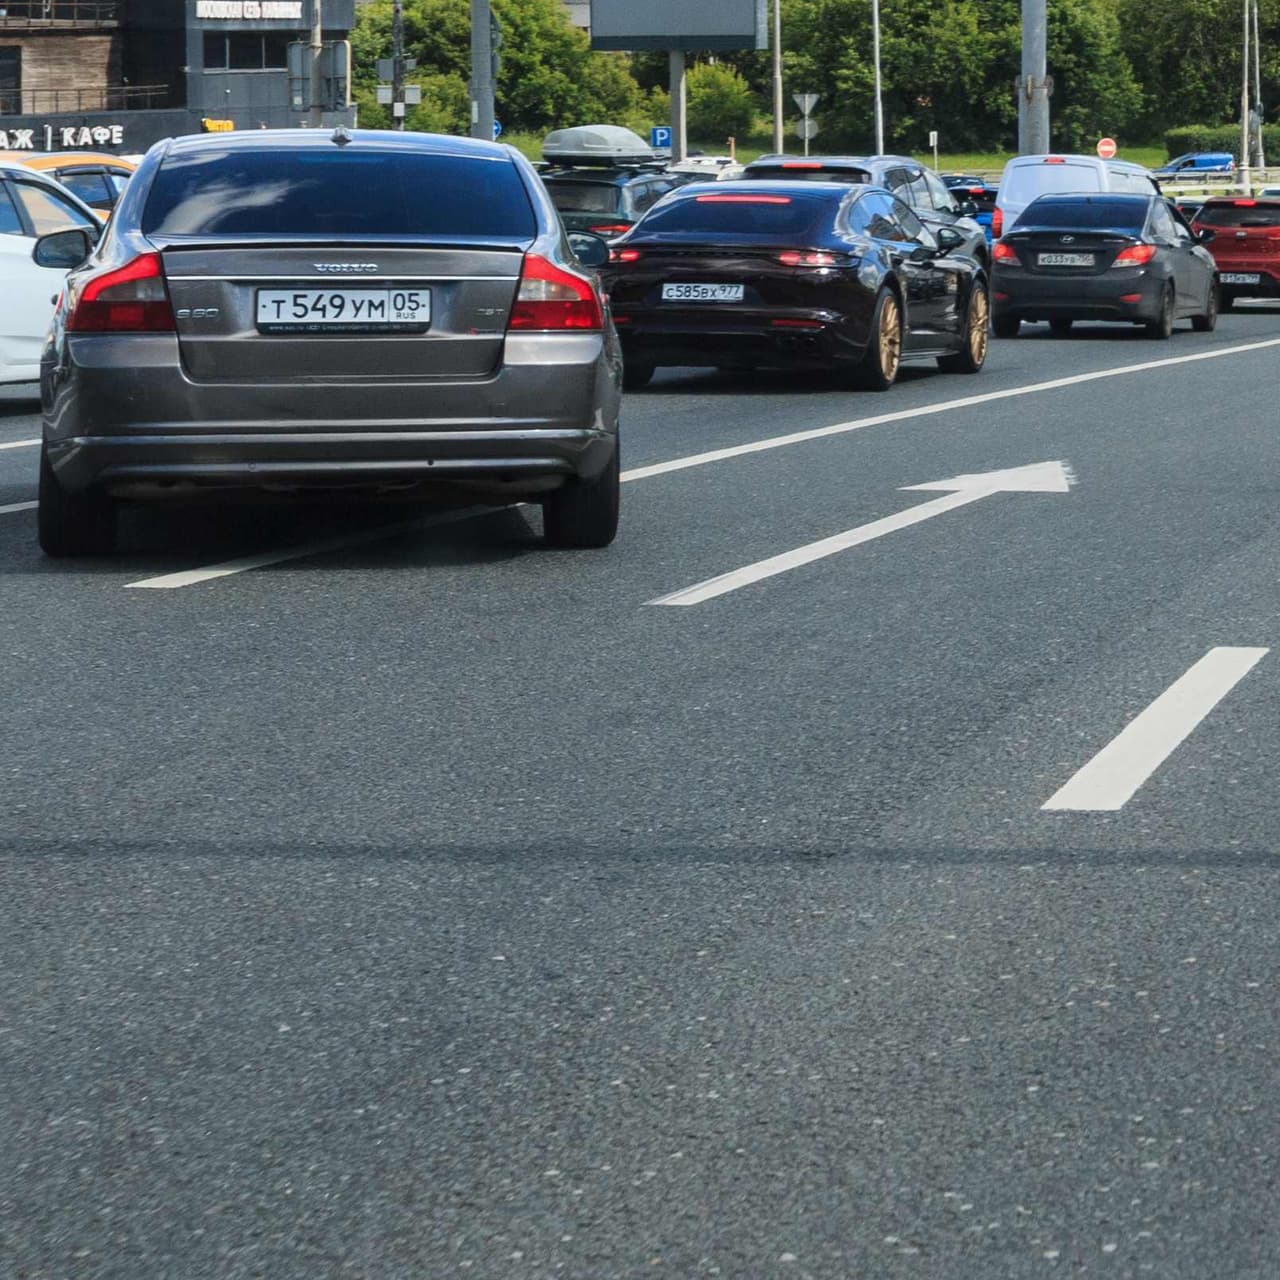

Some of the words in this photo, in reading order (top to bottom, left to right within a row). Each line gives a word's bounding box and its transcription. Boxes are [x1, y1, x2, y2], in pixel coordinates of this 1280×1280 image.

[60, 125, 125, 147] КАФЕ
[313, 263, 379, 272] VOLVO
[395, 311, 417, 320] RUS
